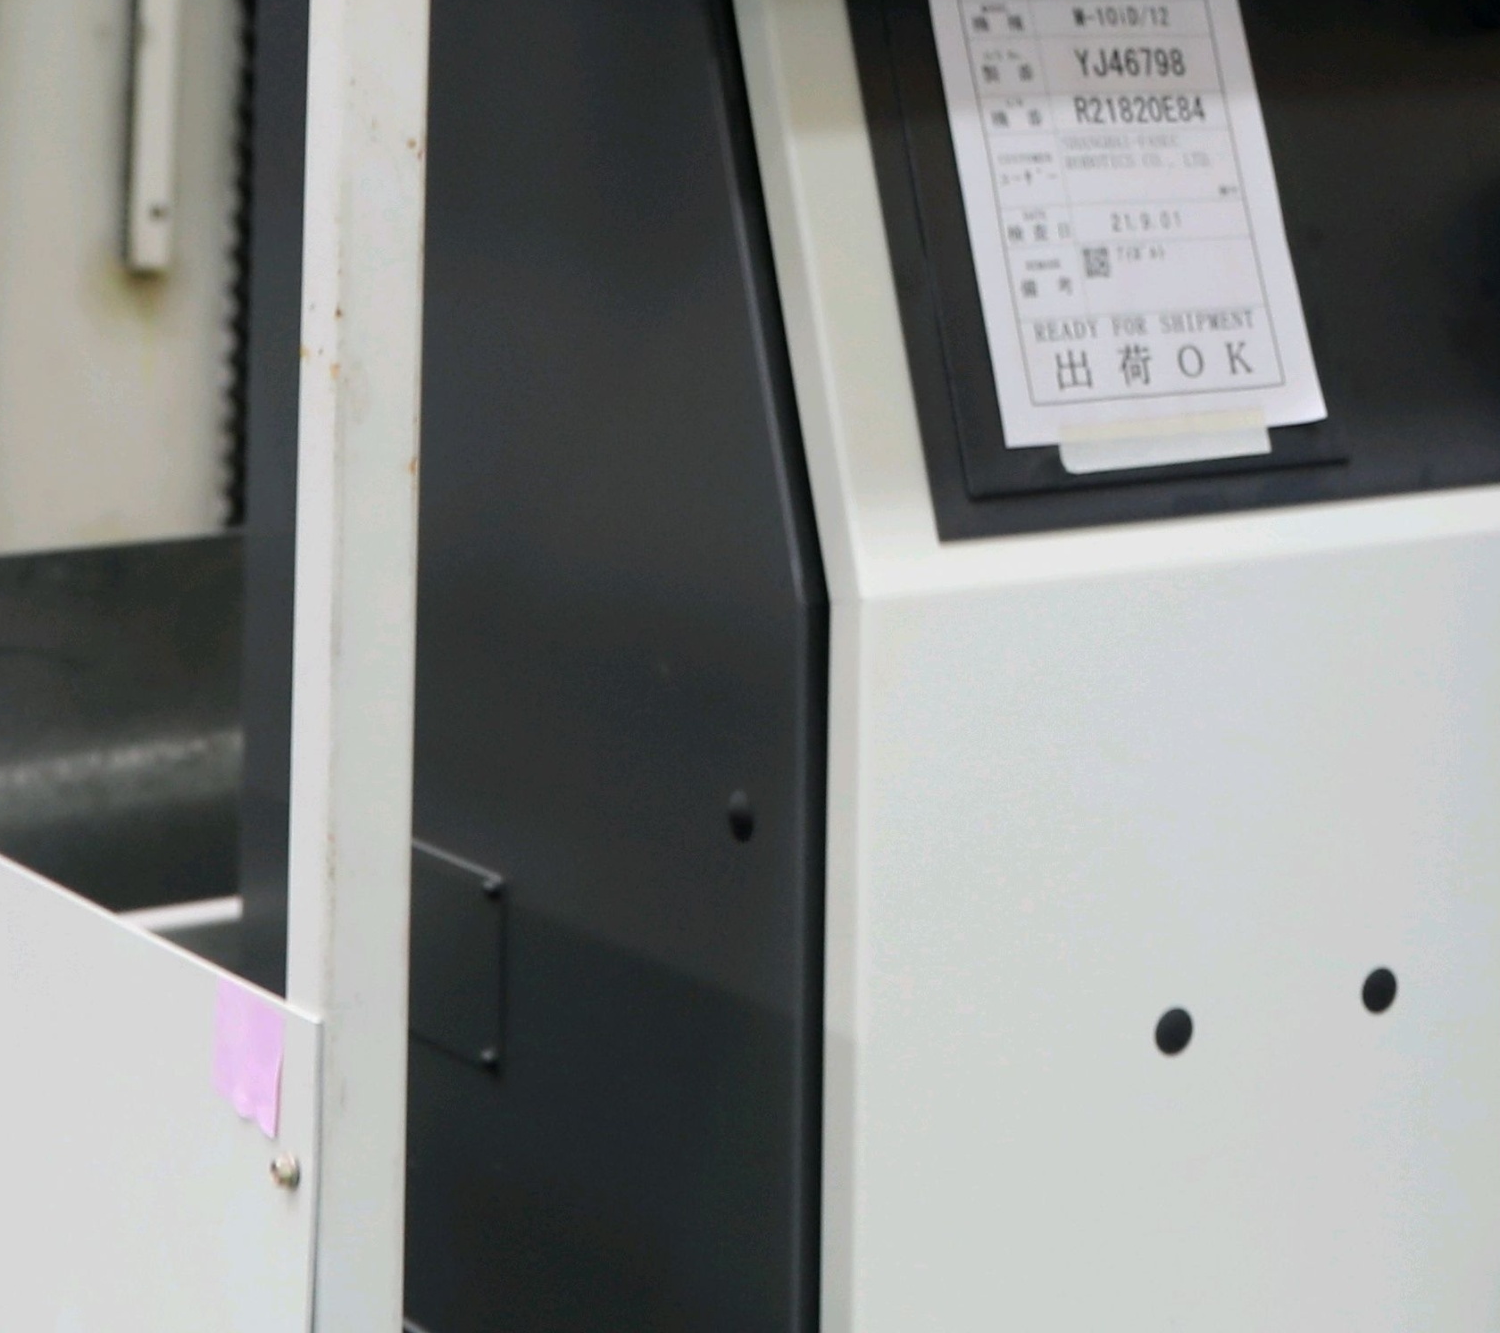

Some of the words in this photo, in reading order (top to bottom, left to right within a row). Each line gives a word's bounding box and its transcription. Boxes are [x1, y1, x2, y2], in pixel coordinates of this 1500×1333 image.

[1073, 47, 1187, 78] YJ46798
[1073, 94, 1206, 126] R21820E84
[1033, 317, 1099, 343] READY
[1110, 314, 1148, 338] FOR
[1158, 309, 1255, 334] SHIPMENT
